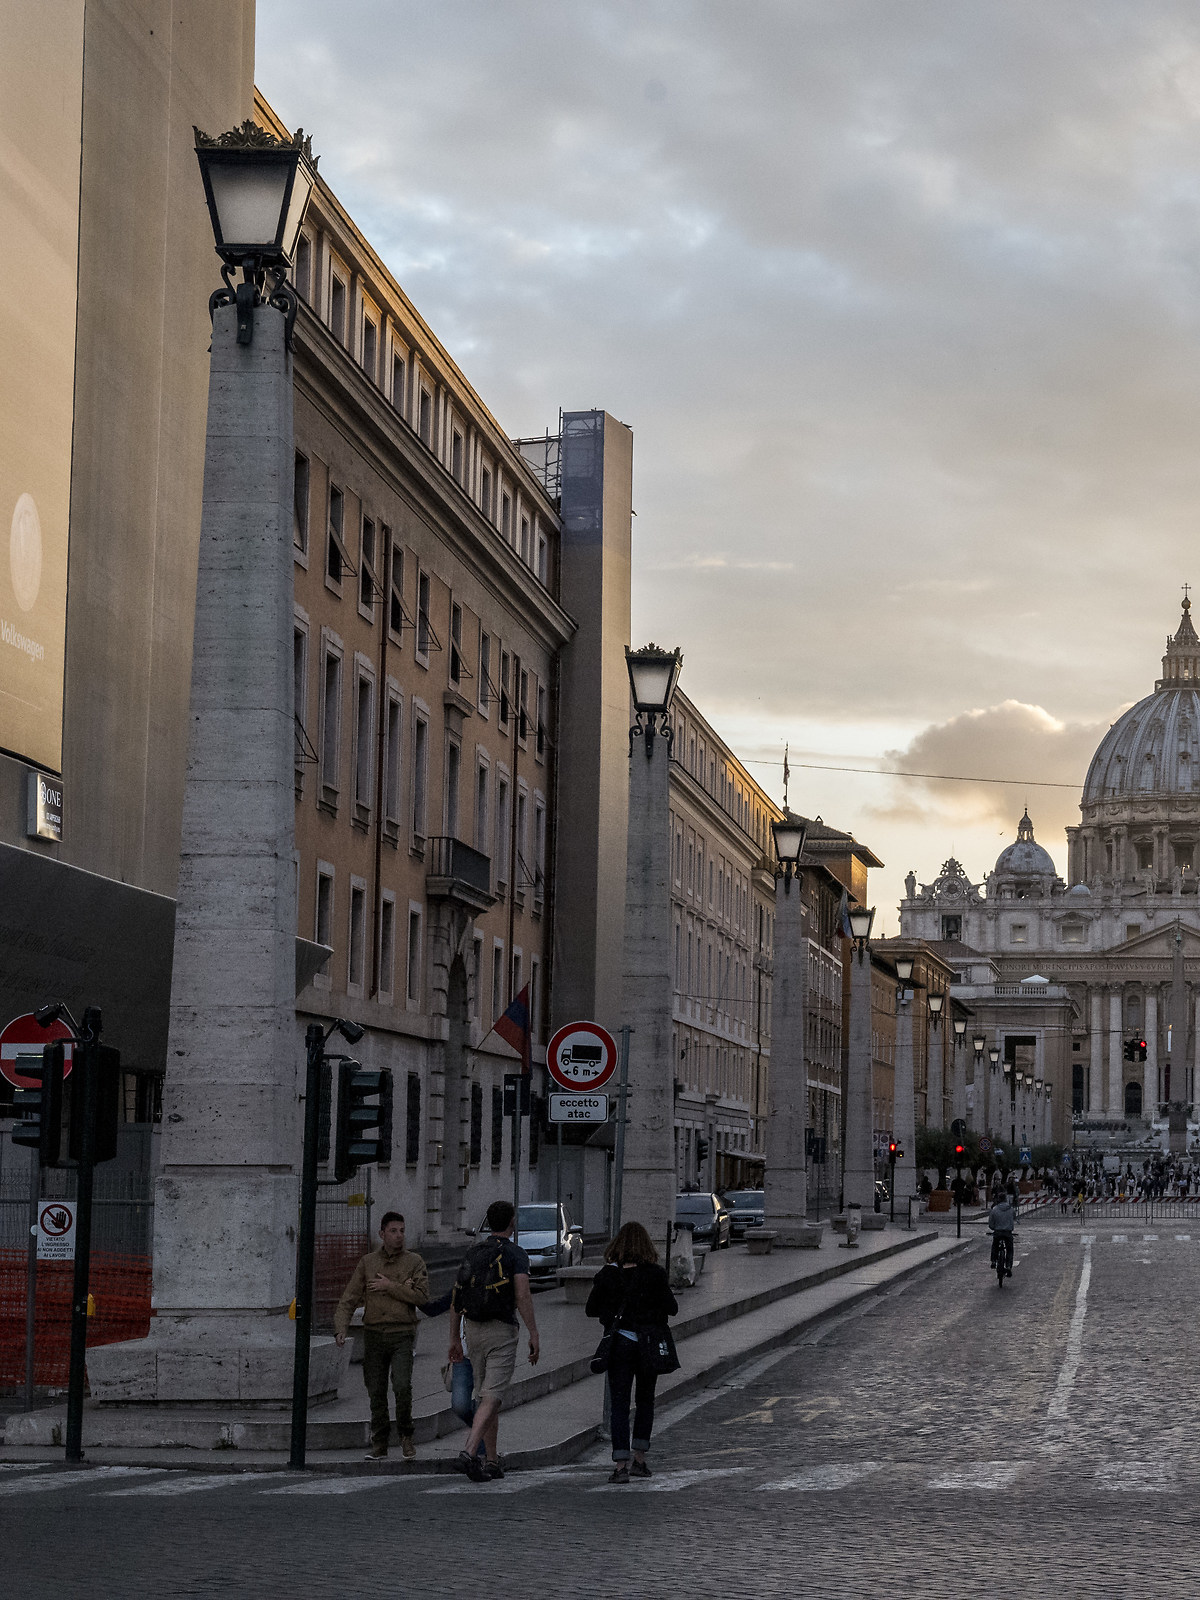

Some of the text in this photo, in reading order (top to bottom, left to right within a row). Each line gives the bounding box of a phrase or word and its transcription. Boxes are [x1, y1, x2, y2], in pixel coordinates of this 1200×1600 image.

[0, 618, 45, 663] Volkswagen
[573, 1066, 578, 1075] 6
[559, 1098, 599, 1107] eccetto
[567, 1109, 591, 1119] atac
